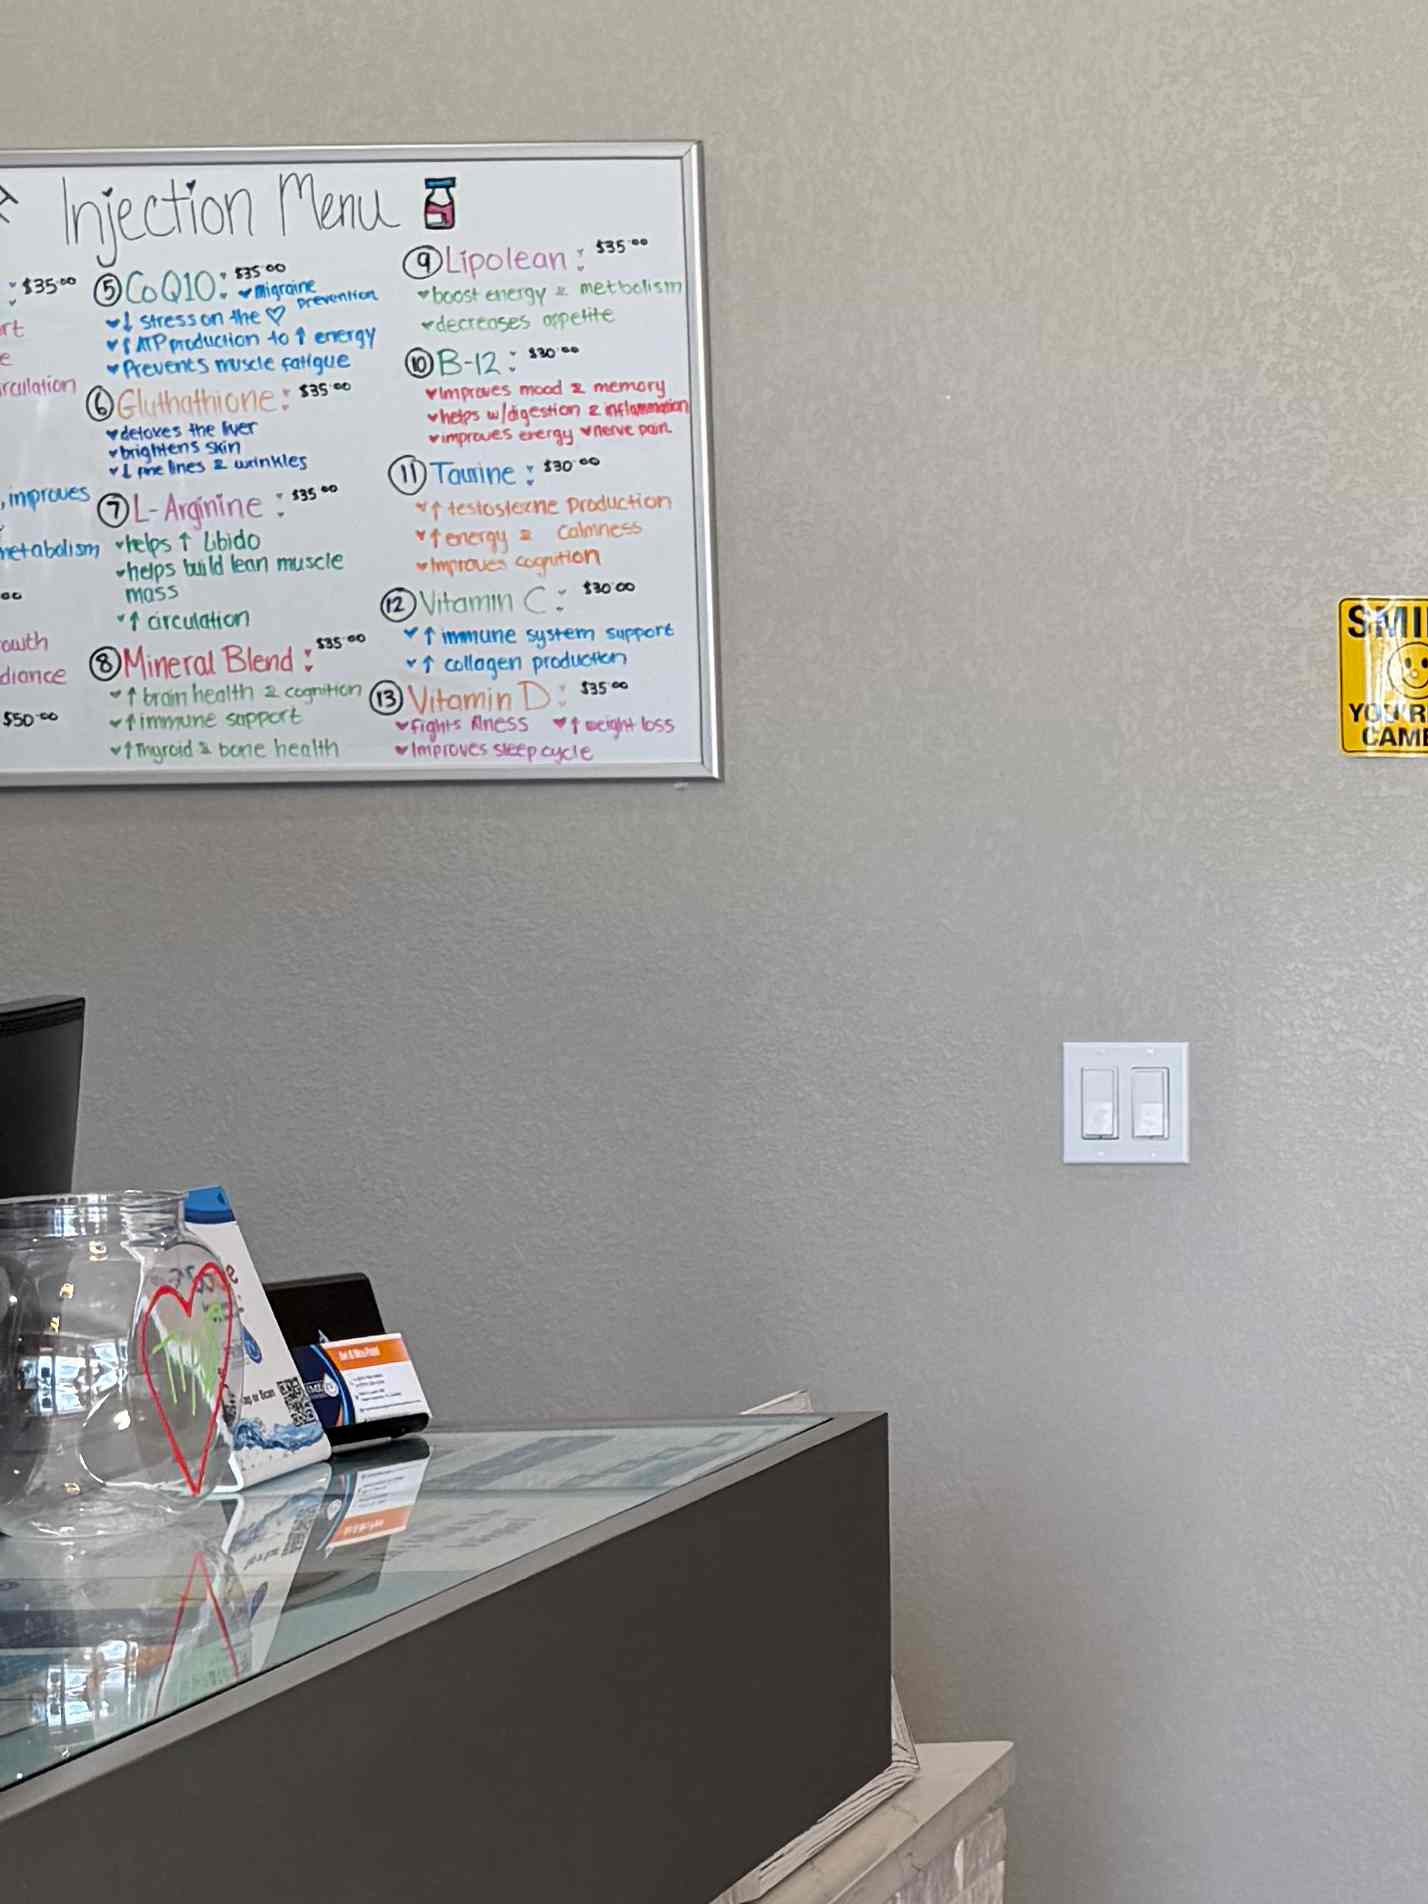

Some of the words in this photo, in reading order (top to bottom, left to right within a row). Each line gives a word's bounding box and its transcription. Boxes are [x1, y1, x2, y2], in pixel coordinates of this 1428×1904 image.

[62, 176, 253, 268] Injection
[279, 172, 401, 237] Menu
[297, 289, 379, 309] prevention
[432, 285, 479, 304] boost
[485, 287, 546, 306] energy
[140, 314, 197, 330] stress
[200, 311, 224, 326] on
[229, 309, 261, 325] the
[436, 314, 530, 333] decreases
[543, 307, 616, 329] appetite
[136, 333, 167, 352] ATP
[169, 332, 260, 353] production
[267, 330, 289, 345] to
[315, 327, 376, 349] energy
[123, 358, 209, 379] Prevents
[215, 356, 275, 372] muscle
[281, 353, 351, 376] fatigue
[519, 379, 562, 396] mood
[593, 380, 666, 399] memory
[440, 407, 480, 426] helps
[188, 422, 215, 438] the
[221, 420, 259, 436] liver
[518, 428, 574, 446] energy
[593, 424, 635, 437] nerve
[637, 422, 673, 437] pain
[120, 440, 200, 464] brightens
[205, 440, 241, 455] skin
[167, 459, 206, 474] lines
[234, 454, 308, 471] wrinkles
[125, 532, 172, 559] helps
[445, 529, 509, 554] energy
[126, 561, 177, 584] helps
[183, 554, 225, 577] build
[230, 553, 269, 574] lean
[276, 551, 345, 571] muscle
[515, 548, 602, 577] cognition
[125, 584, 179, 604] mass
[419, 589, 514, 616] Vitamin
[147, 609, 250, 631] circulation
[442, 627, 517, 645] immune
[526, 626, 595, 649] system
[605, 623, 675, 644] support
[123, 644, 217, 680] Mineral
[444, 654, 523, 680] collagen
[532, 650, 628, 675] production
[143, 686, 188, 707] brain
[191, 682, 254, 705] health
[284, 683, 363, 705] cognition
[406, 684, 513, 714] Vitamin
[140, 712, 217, 730] immune
[225, 707, 303, 730] support
[641, 715, 675, 733] loss
[218, 741, 266, 758] bone
[273, 737, 339, 758] health
[540, 744, 595, 764] cycle
